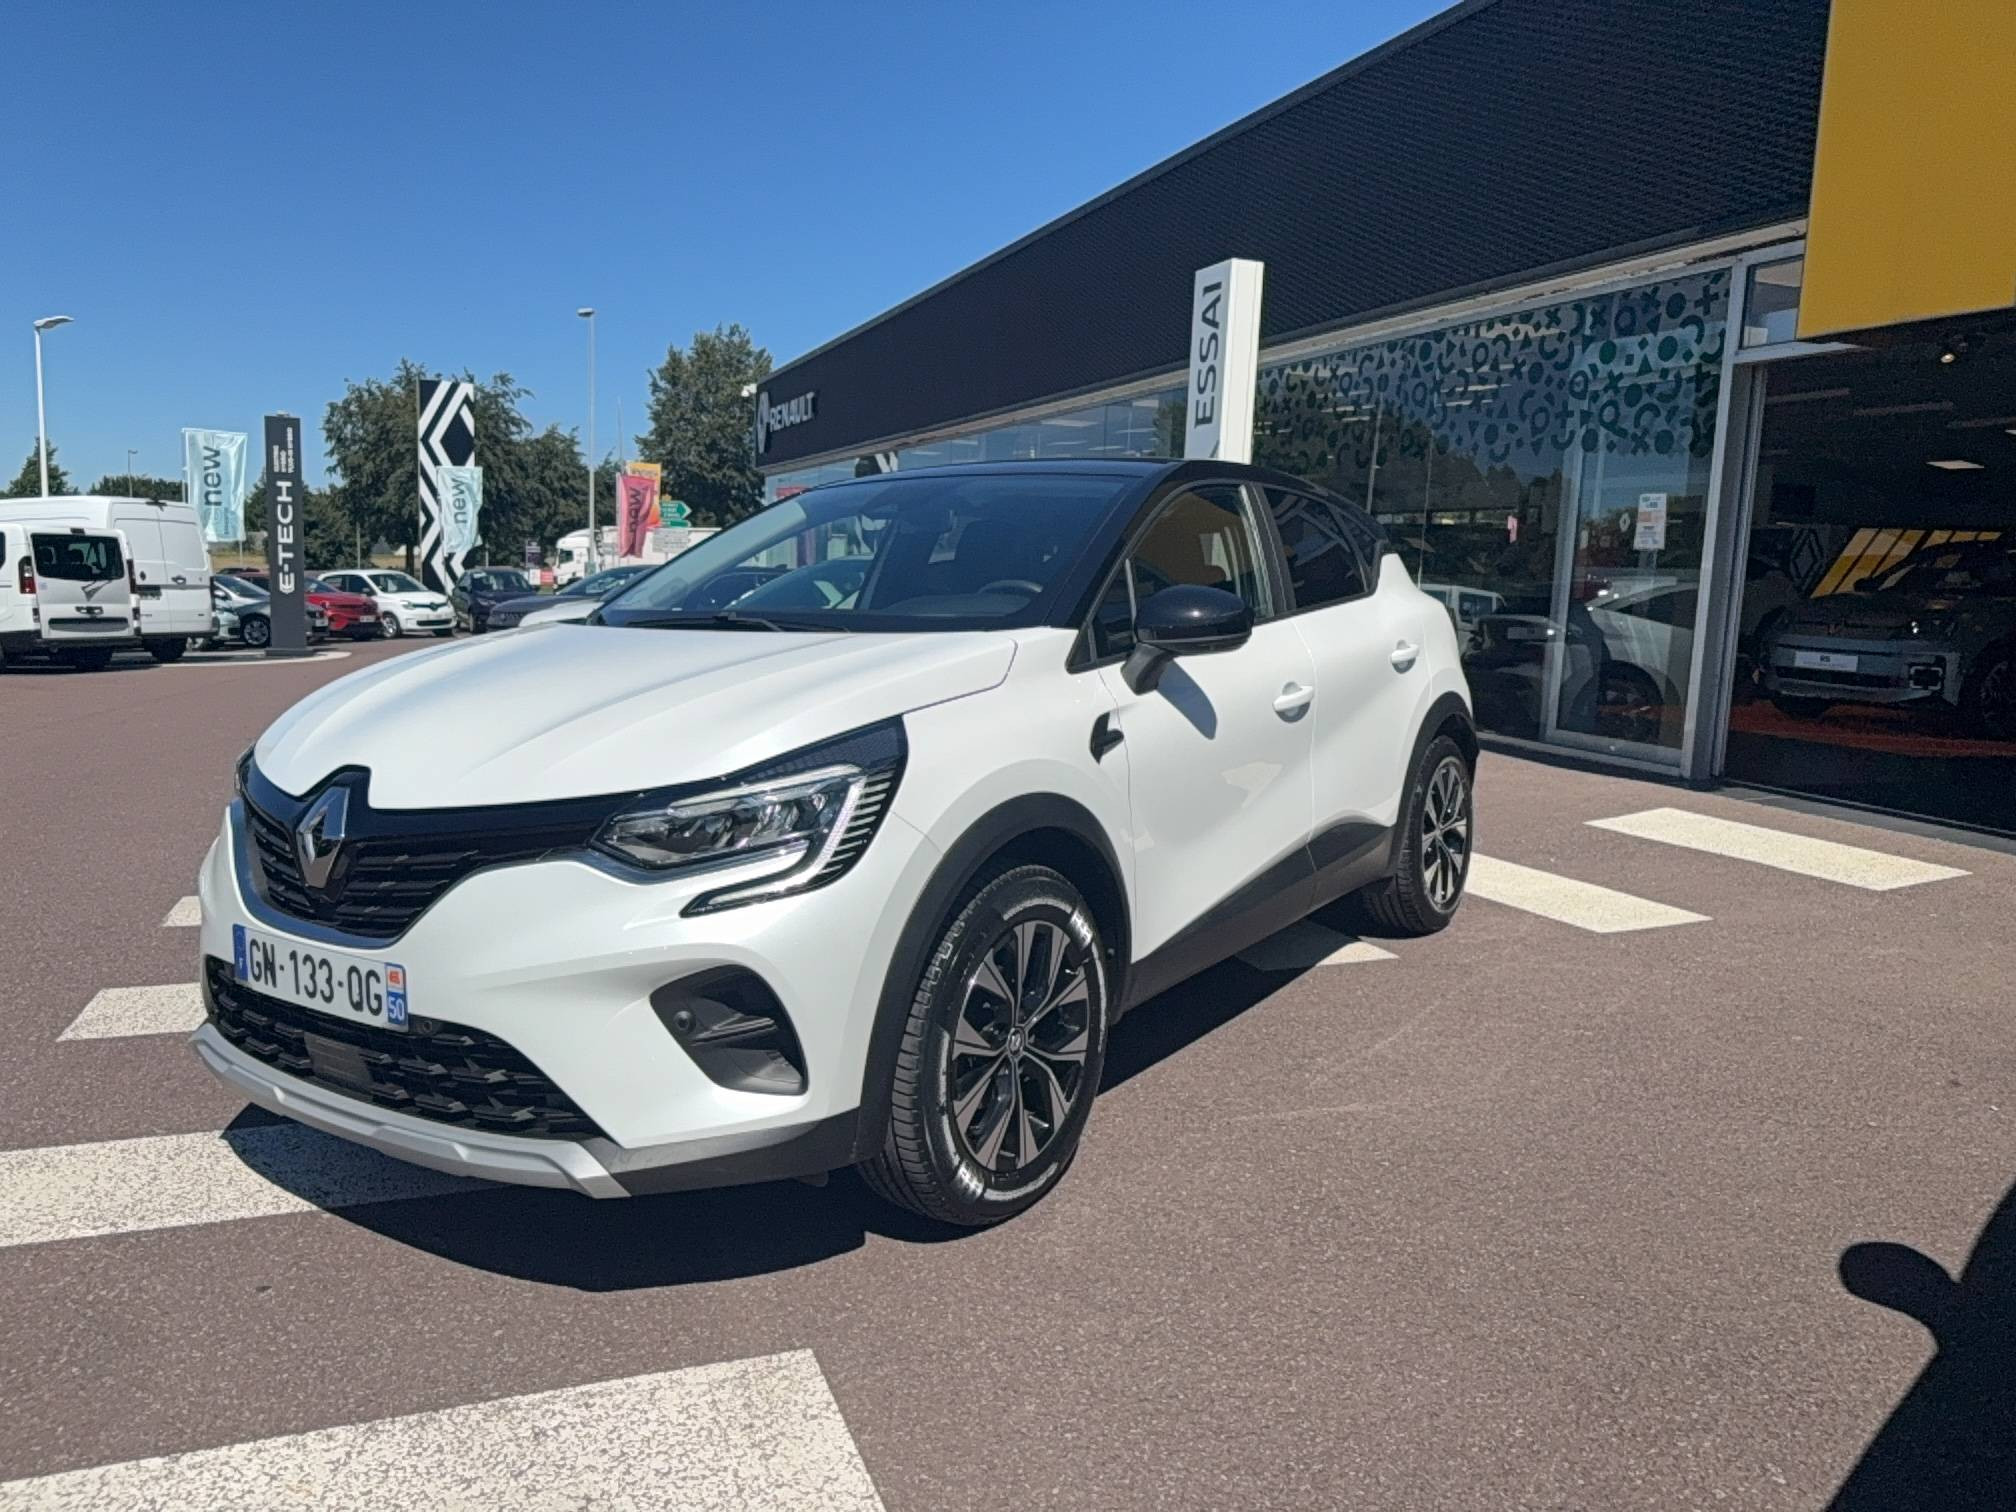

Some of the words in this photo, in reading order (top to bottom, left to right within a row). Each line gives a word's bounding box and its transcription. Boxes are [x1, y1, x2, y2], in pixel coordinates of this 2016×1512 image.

[1194, 281, 1223, 428] ESSAI
[769, 391, 815, 433] RENAULT
[203, 445, 222, 507] new
[451, 477, 468, 524] new
[275, 480, 295, 595] E-TECH
[249, 938, 383, 1016] GN-133-QG
[388, 995, 405, 1021] 50
